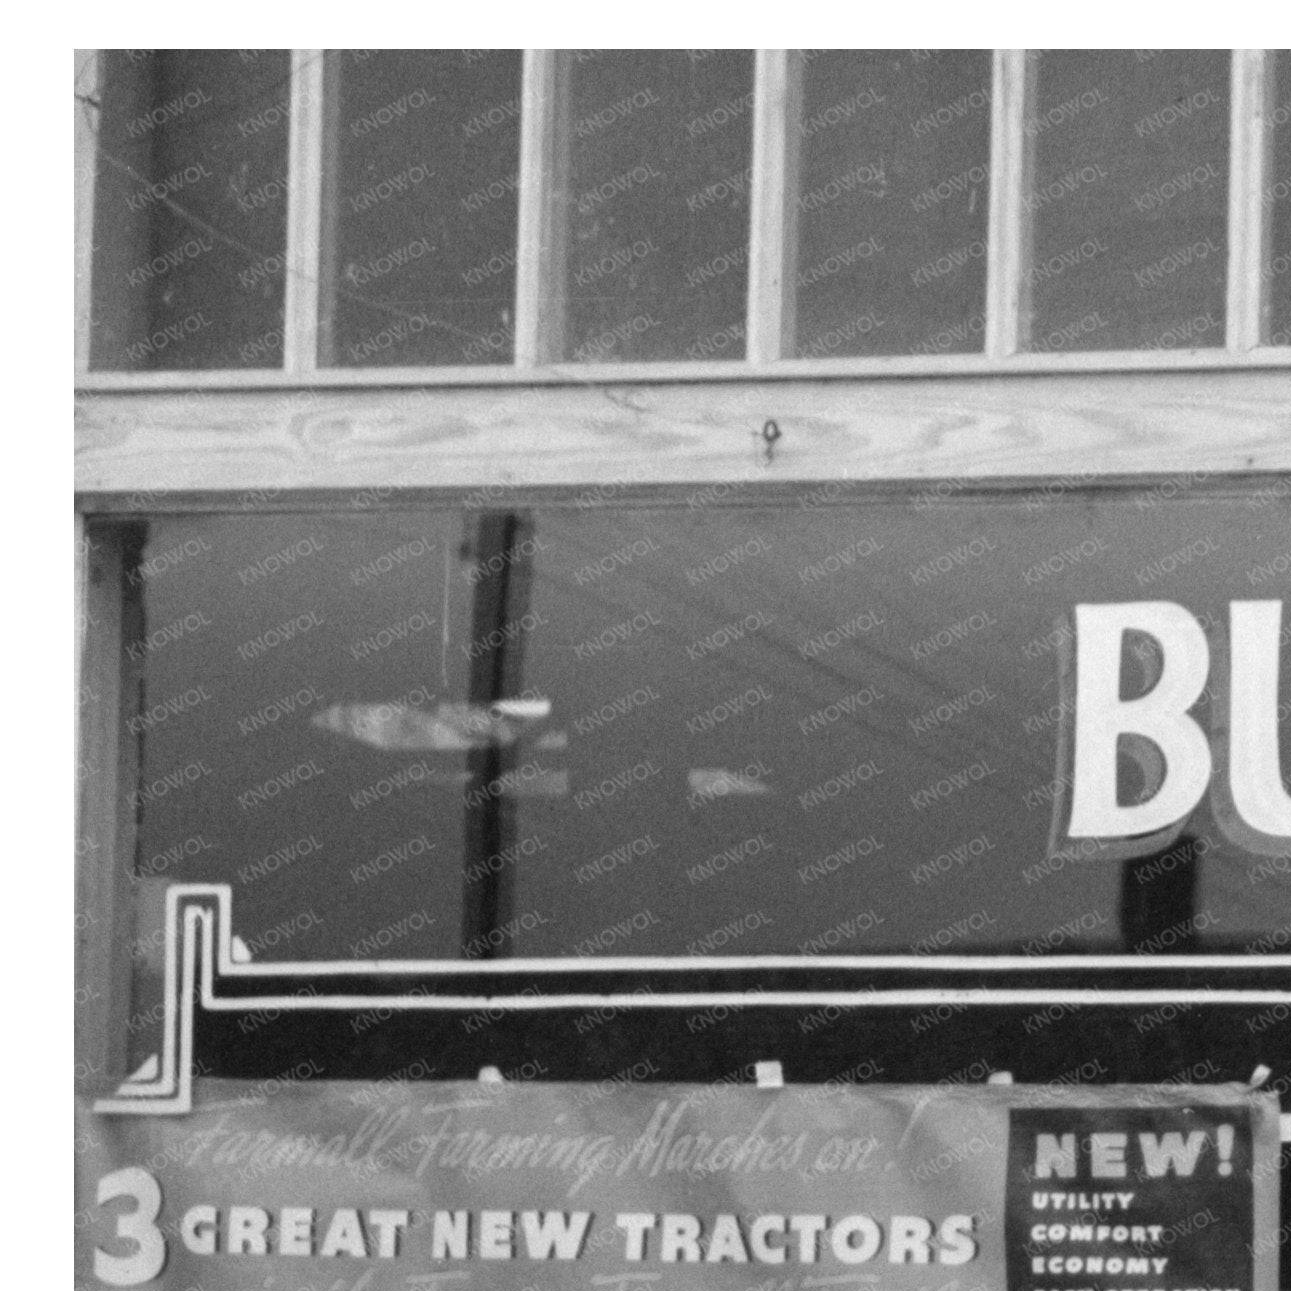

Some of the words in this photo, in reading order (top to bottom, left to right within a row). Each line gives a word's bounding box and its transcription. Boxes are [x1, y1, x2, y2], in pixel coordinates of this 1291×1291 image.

[1036, 1126, 1234, 1178] NEW!
[1031, 1191, 1134, 1210] UTILITY
[93, 1166, 165, 1286] 3
[180, 1204, 407, 1257] GREAT
[432, 1209, 592, 1260] NEW
[616, 1212, 976, 1265] TRACTORS
[1031, 1224, 1163, 1243] COMFORT
[1031, 1257, 1168, 1275] ECONOMY
